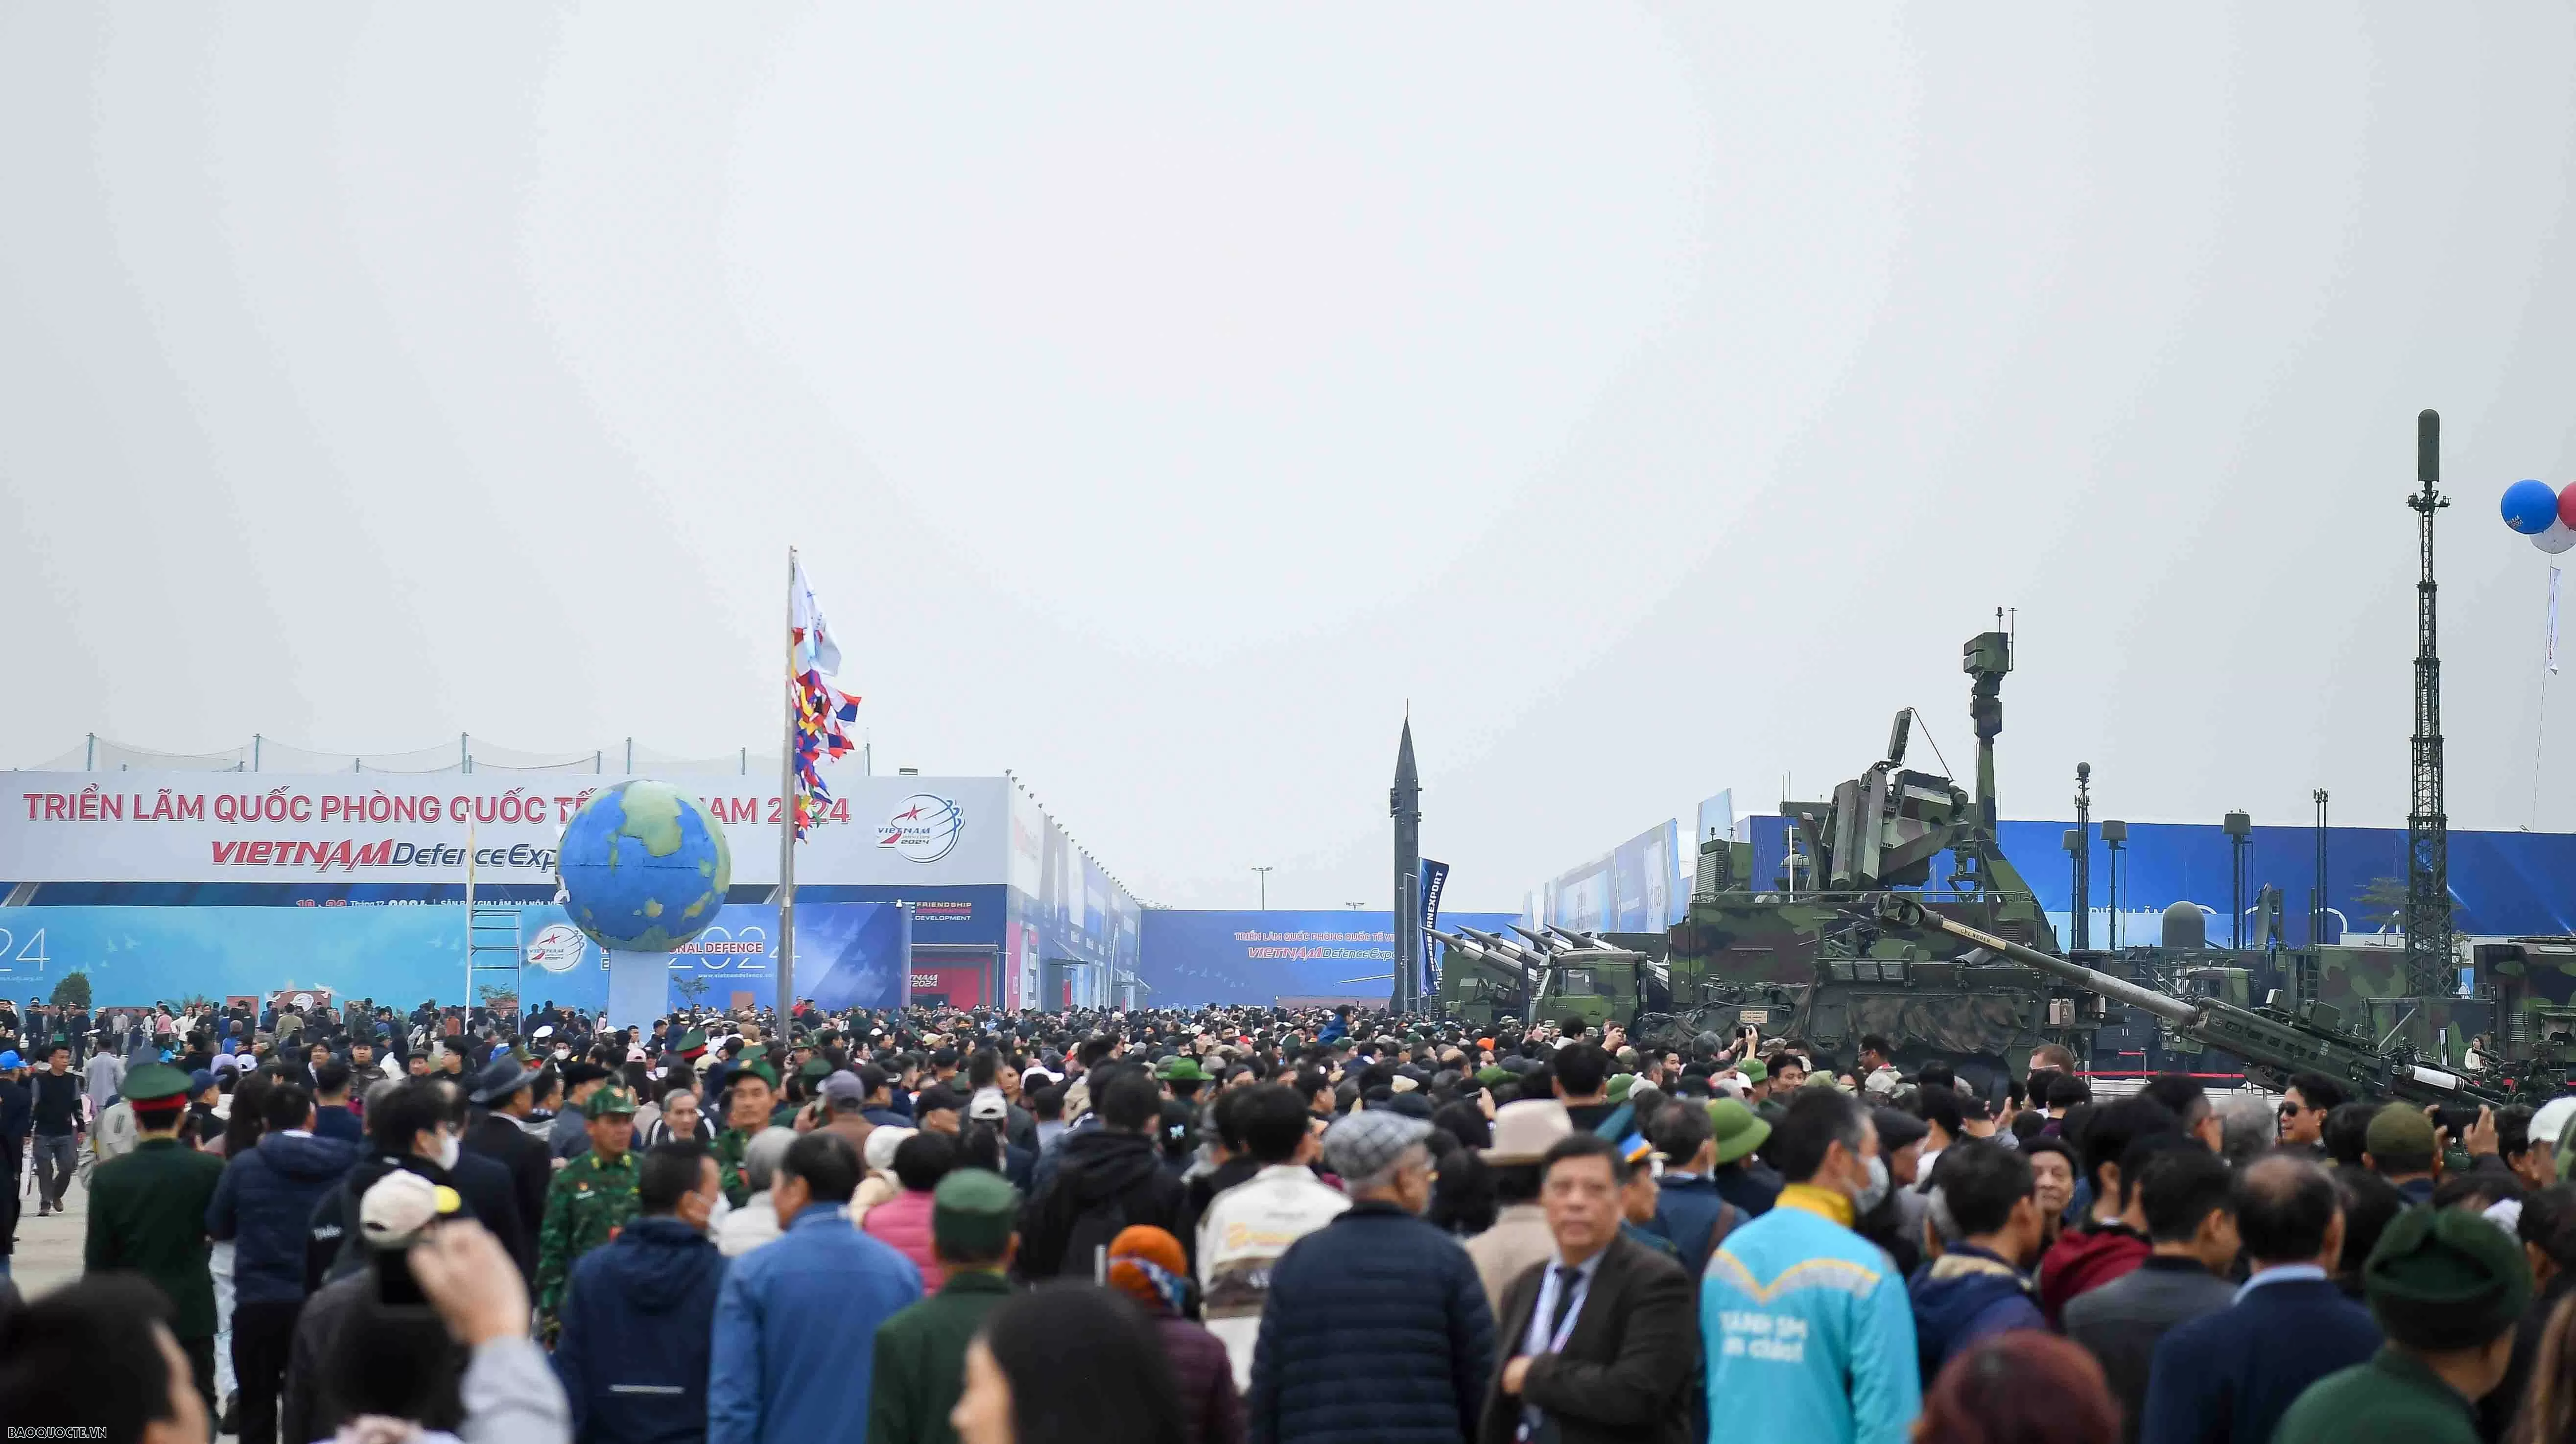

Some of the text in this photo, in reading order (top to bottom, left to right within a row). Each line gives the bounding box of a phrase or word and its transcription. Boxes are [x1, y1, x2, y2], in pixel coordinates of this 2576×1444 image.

[23, 783, 124, 821] TRIỂN
[133, 788, 204, 822] LÃM
[214, 785, 312, 824] QUỐC
[321, 787, 441, 823] PHÒNG
[699, 796, 758, 825] AM
[767, 796, 851, 825] 224
[705, 942, 763, 954] DEFENCE
